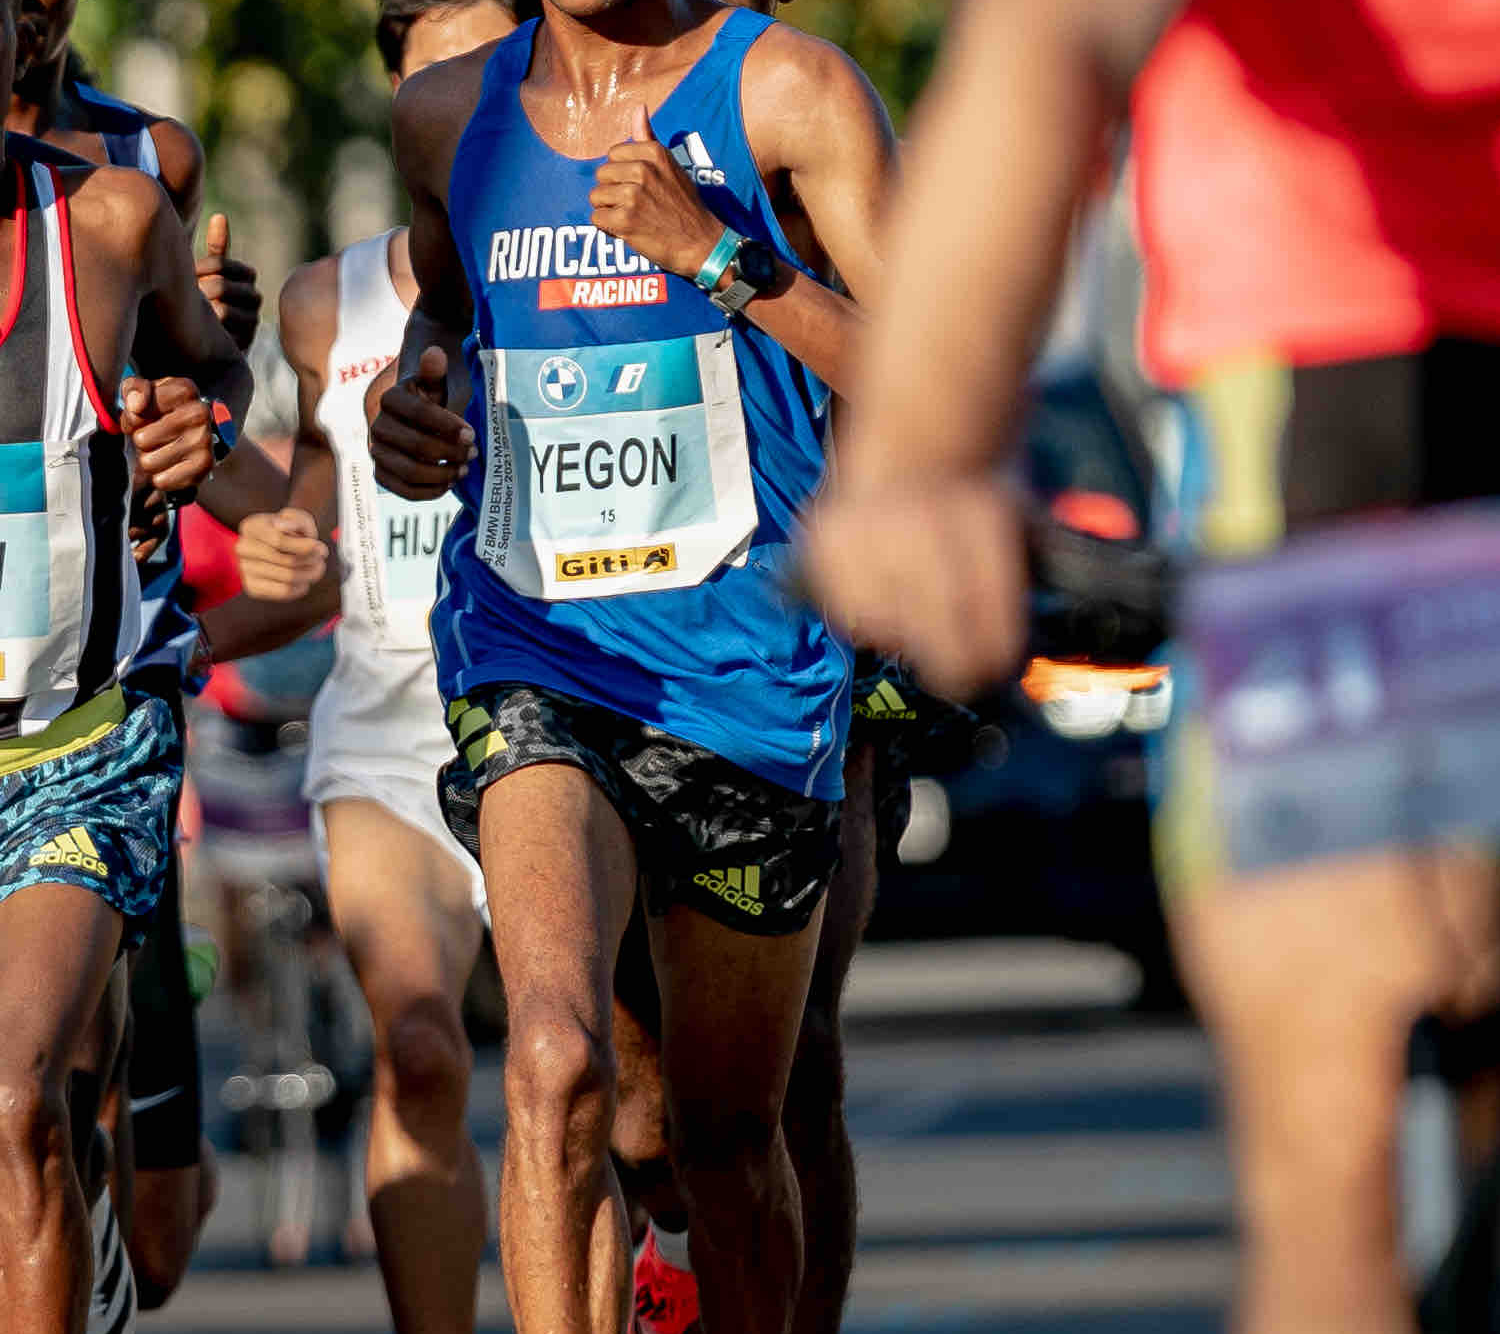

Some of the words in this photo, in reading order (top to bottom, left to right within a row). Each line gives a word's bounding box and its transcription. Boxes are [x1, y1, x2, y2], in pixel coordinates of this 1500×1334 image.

[488, 226, 661, 283] RUNCZEC
[572, 277, 660, 305] RACING
[531, 434, 678, 494] YEGON
[485, 515, 500, 548] BMW
[498, 485, 514, 550] September
[600, 509, 616, 524] 15
[560, 554, 629, 578] Giti
[29, 848, 109, 876] adidas
[693, 873, 765, 916] adidas
